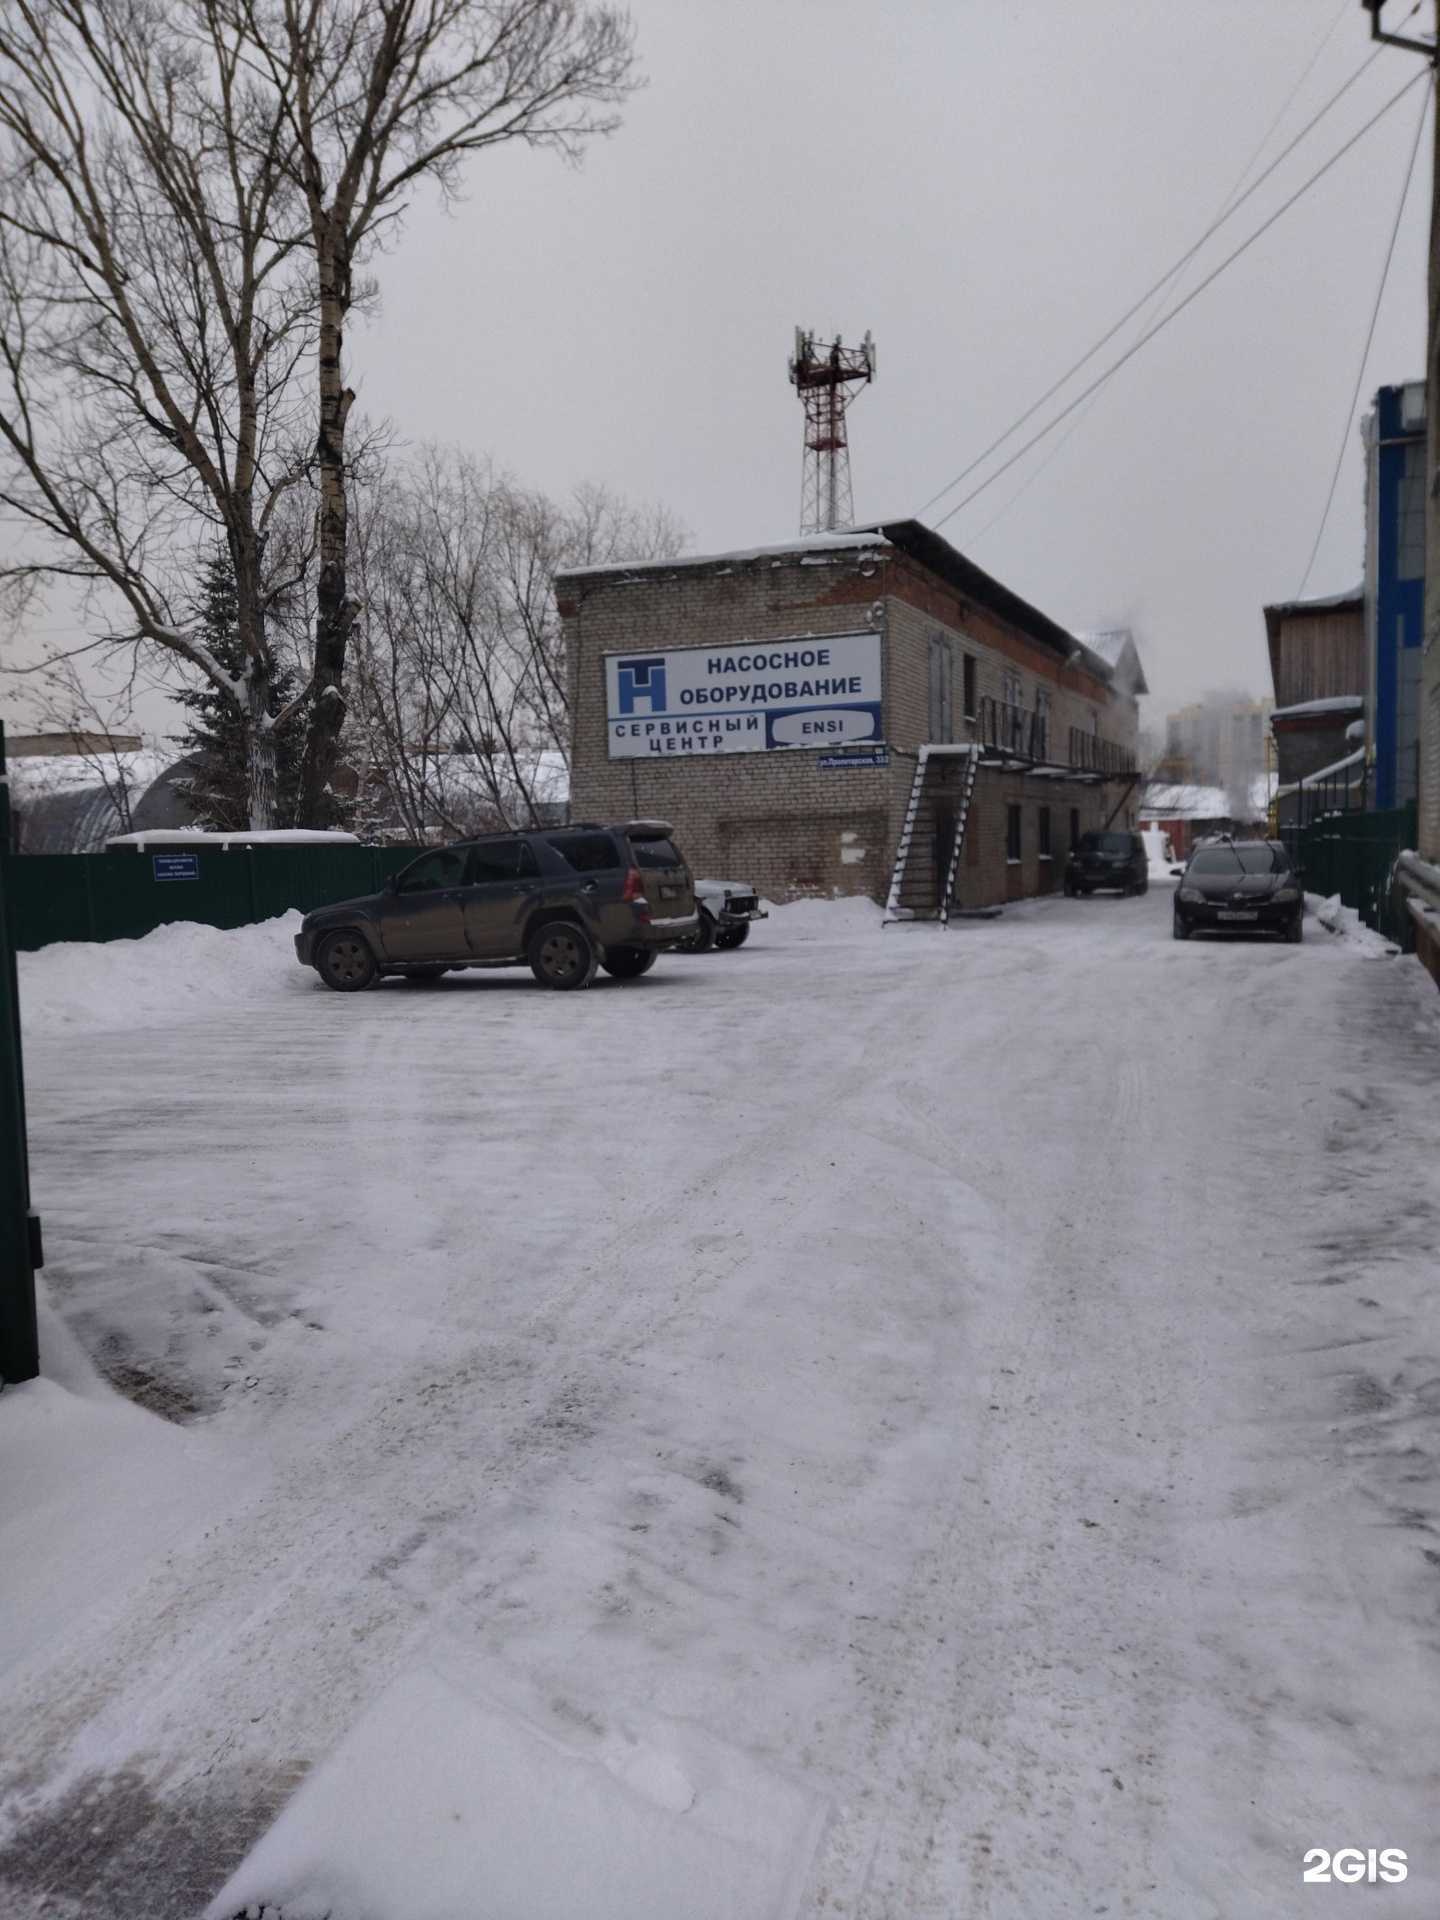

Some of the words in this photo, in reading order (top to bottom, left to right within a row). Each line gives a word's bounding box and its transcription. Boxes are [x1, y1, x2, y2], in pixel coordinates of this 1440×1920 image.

[707, 649, 830, 675] НАСОСНОЕ
[680, 676, 862, 705] ОБОРУДОВАНИЕ
[615, 715, 759, 738] СЕРВИСНЫЙ
[801, 720, 844, 734] ENSI
[649, 735, 724, 753] ЦЕНТР
